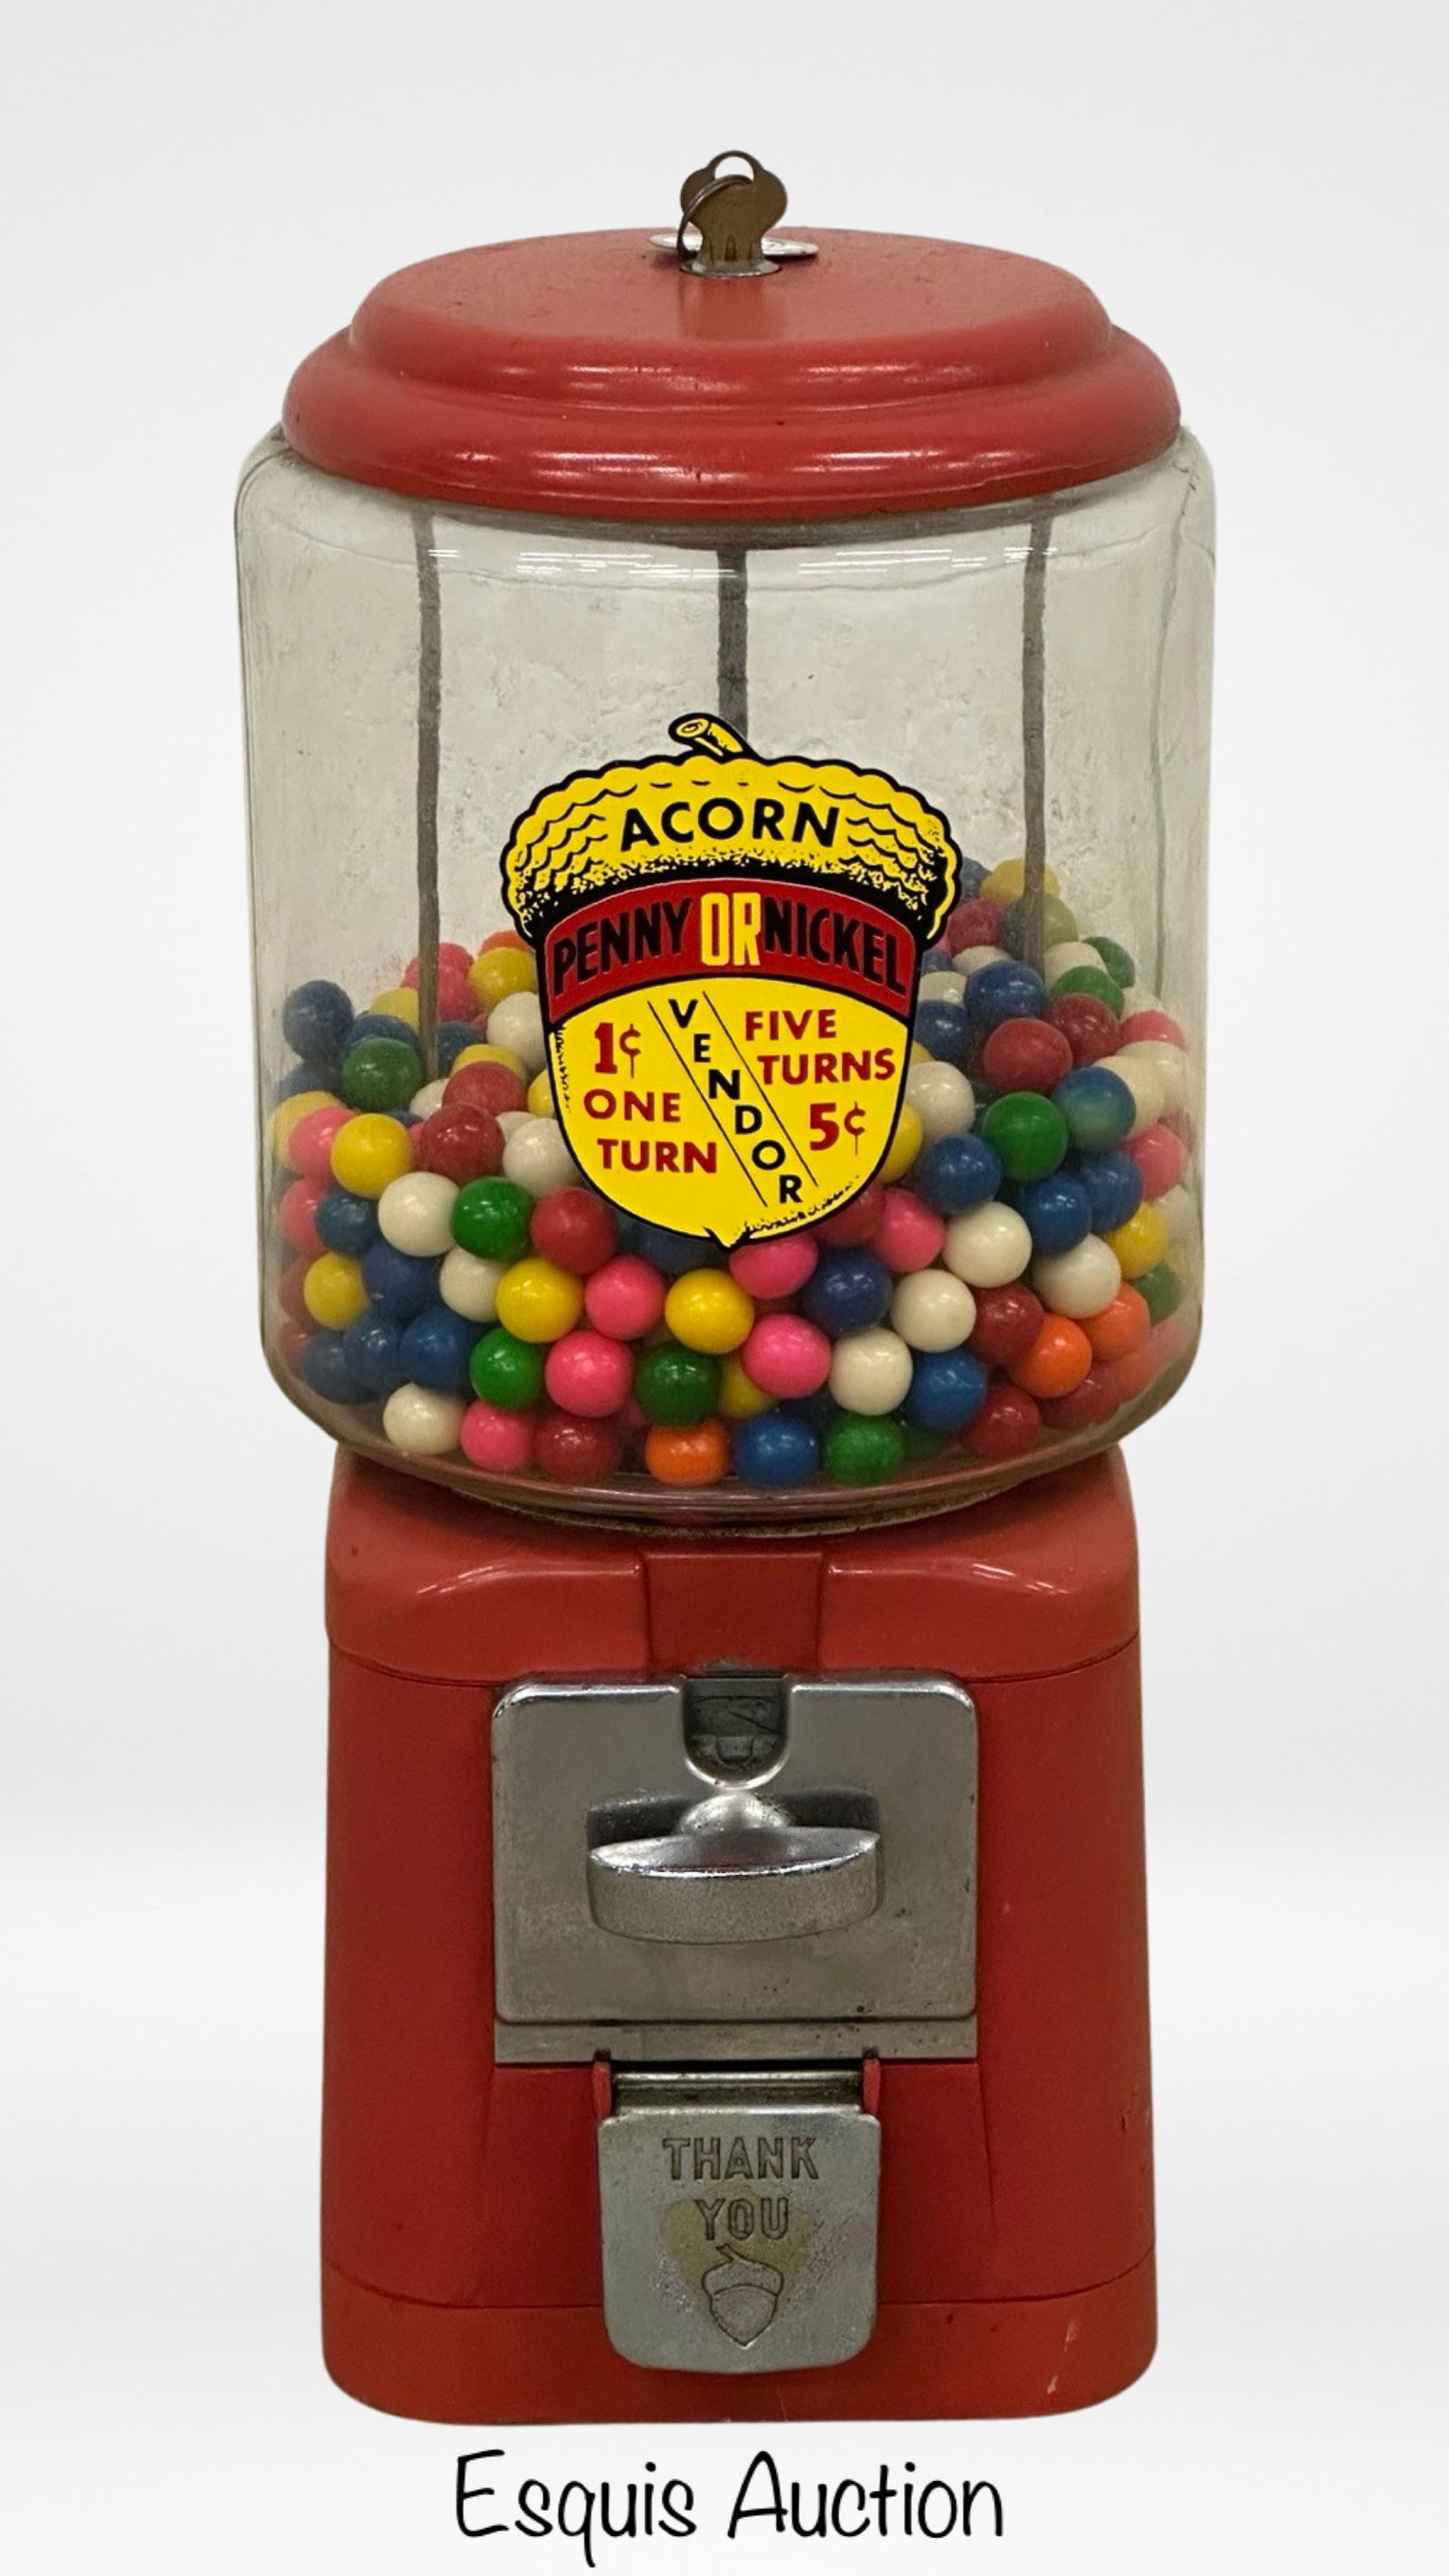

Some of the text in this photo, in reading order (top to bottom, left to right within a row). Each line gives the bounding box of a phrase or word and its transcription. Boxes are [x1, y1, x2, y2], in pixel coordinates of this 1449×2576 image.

[620, 797, 840, 852] ACORN
[553, 892, 906, 996] PENNY OR NICKEL
[744, 1008, 837, 1041] FIVE
[593, 1022, 642, 1079] 1¢
[757, 1048, 896, 1085] TURNS
[583, 1089, 681, 1122] ONE
[668, 998, 802, 1204] VENDOR
[809, 1101, 866, 1155] 5¢
[598, 1139, 717, 1174] TURN
[662, 2137, 820, 2180] THANK
[695, 2197, 790, 2241] YOU
